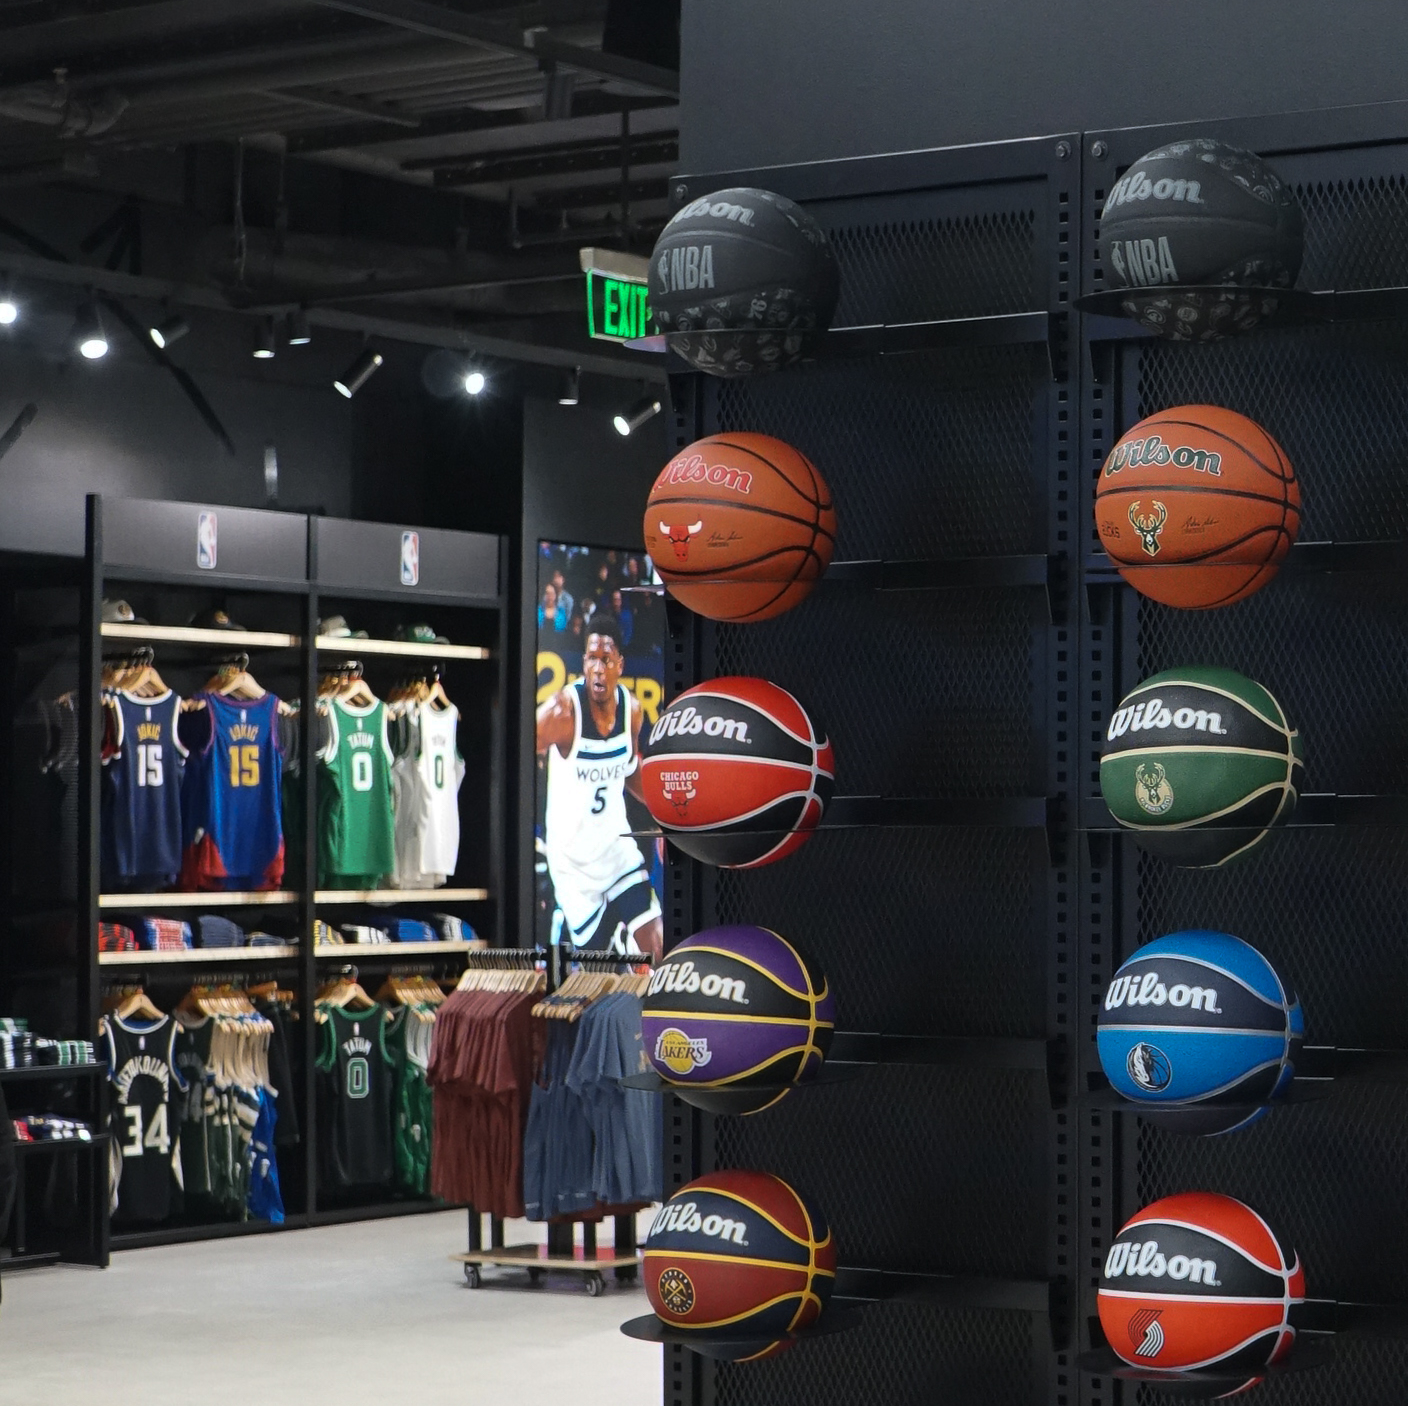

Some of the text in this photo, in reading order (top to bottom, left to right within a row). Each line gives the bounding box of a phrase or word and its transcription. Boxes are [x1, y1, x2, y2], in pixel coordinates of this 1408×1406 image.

[671, 246, 715, 291] NBA
[1125, 237, 1179, 286] NBA
[604, 279, 649, 338] EXIT
[1105, 436, 1222, 477] Wilson
[649, 707, 748, 745] Wilson
[1106, 698, 1222, 741] Wilson
[137, 745, 163, 787] 15
[228, 745, 260, 787] 15
[352, 751, 373, 791] 0
[659, 771, 699, 782] CHICAGO
[665, 781, 692, 790] BULLS
[591, 787, 607, 814] 5
[648, 961, 747, 1003] Wilson
[1105, 972, 1218, 1013] Wilson
[658, 1039, 705, 1064] LAKERS
[347, 1057, 369, 1099] 0
[122, 1104, 171, 1156] 34
[650, 1202, 747, 1244] Wilson
[1104, 1240, 1217, 1286] Wilson
